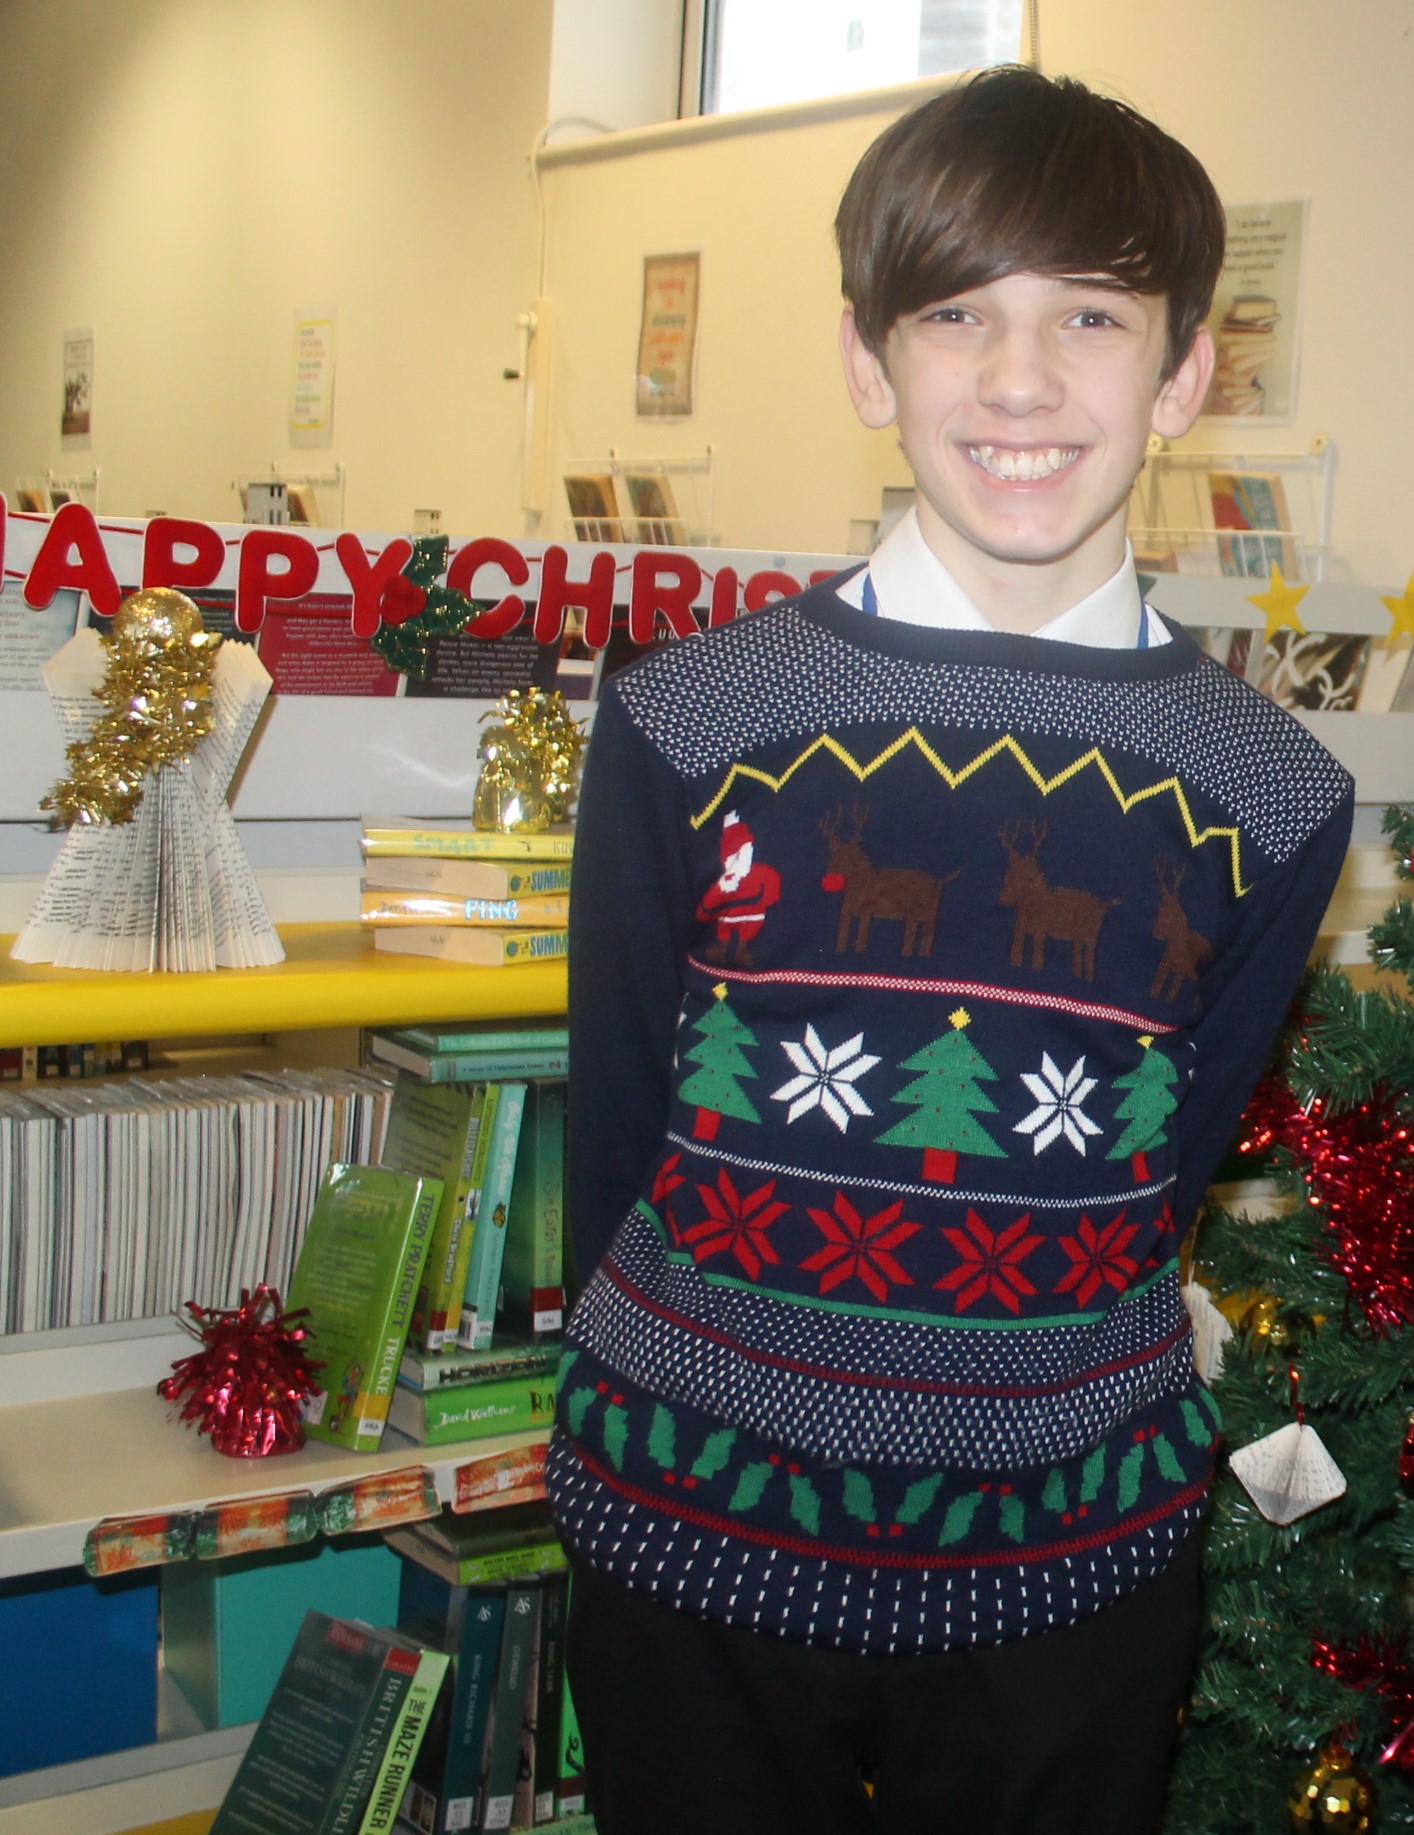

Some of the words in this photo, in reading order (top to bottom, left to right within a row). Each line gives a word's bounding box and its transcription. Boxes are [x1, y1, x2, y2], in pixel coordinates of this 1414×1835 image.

[0, 492, 413, 638] APPY
[464, 899, 518, 920] FING
[413, 1194, 435, 1239] TERRY
[392, 1245, 424, 1328] PRATCHETT
[408, 1698, 427, 1715] THE
[391, 1714, 422, 1761] MAZE
[369, 1762, 407, 1831] RUNNER
